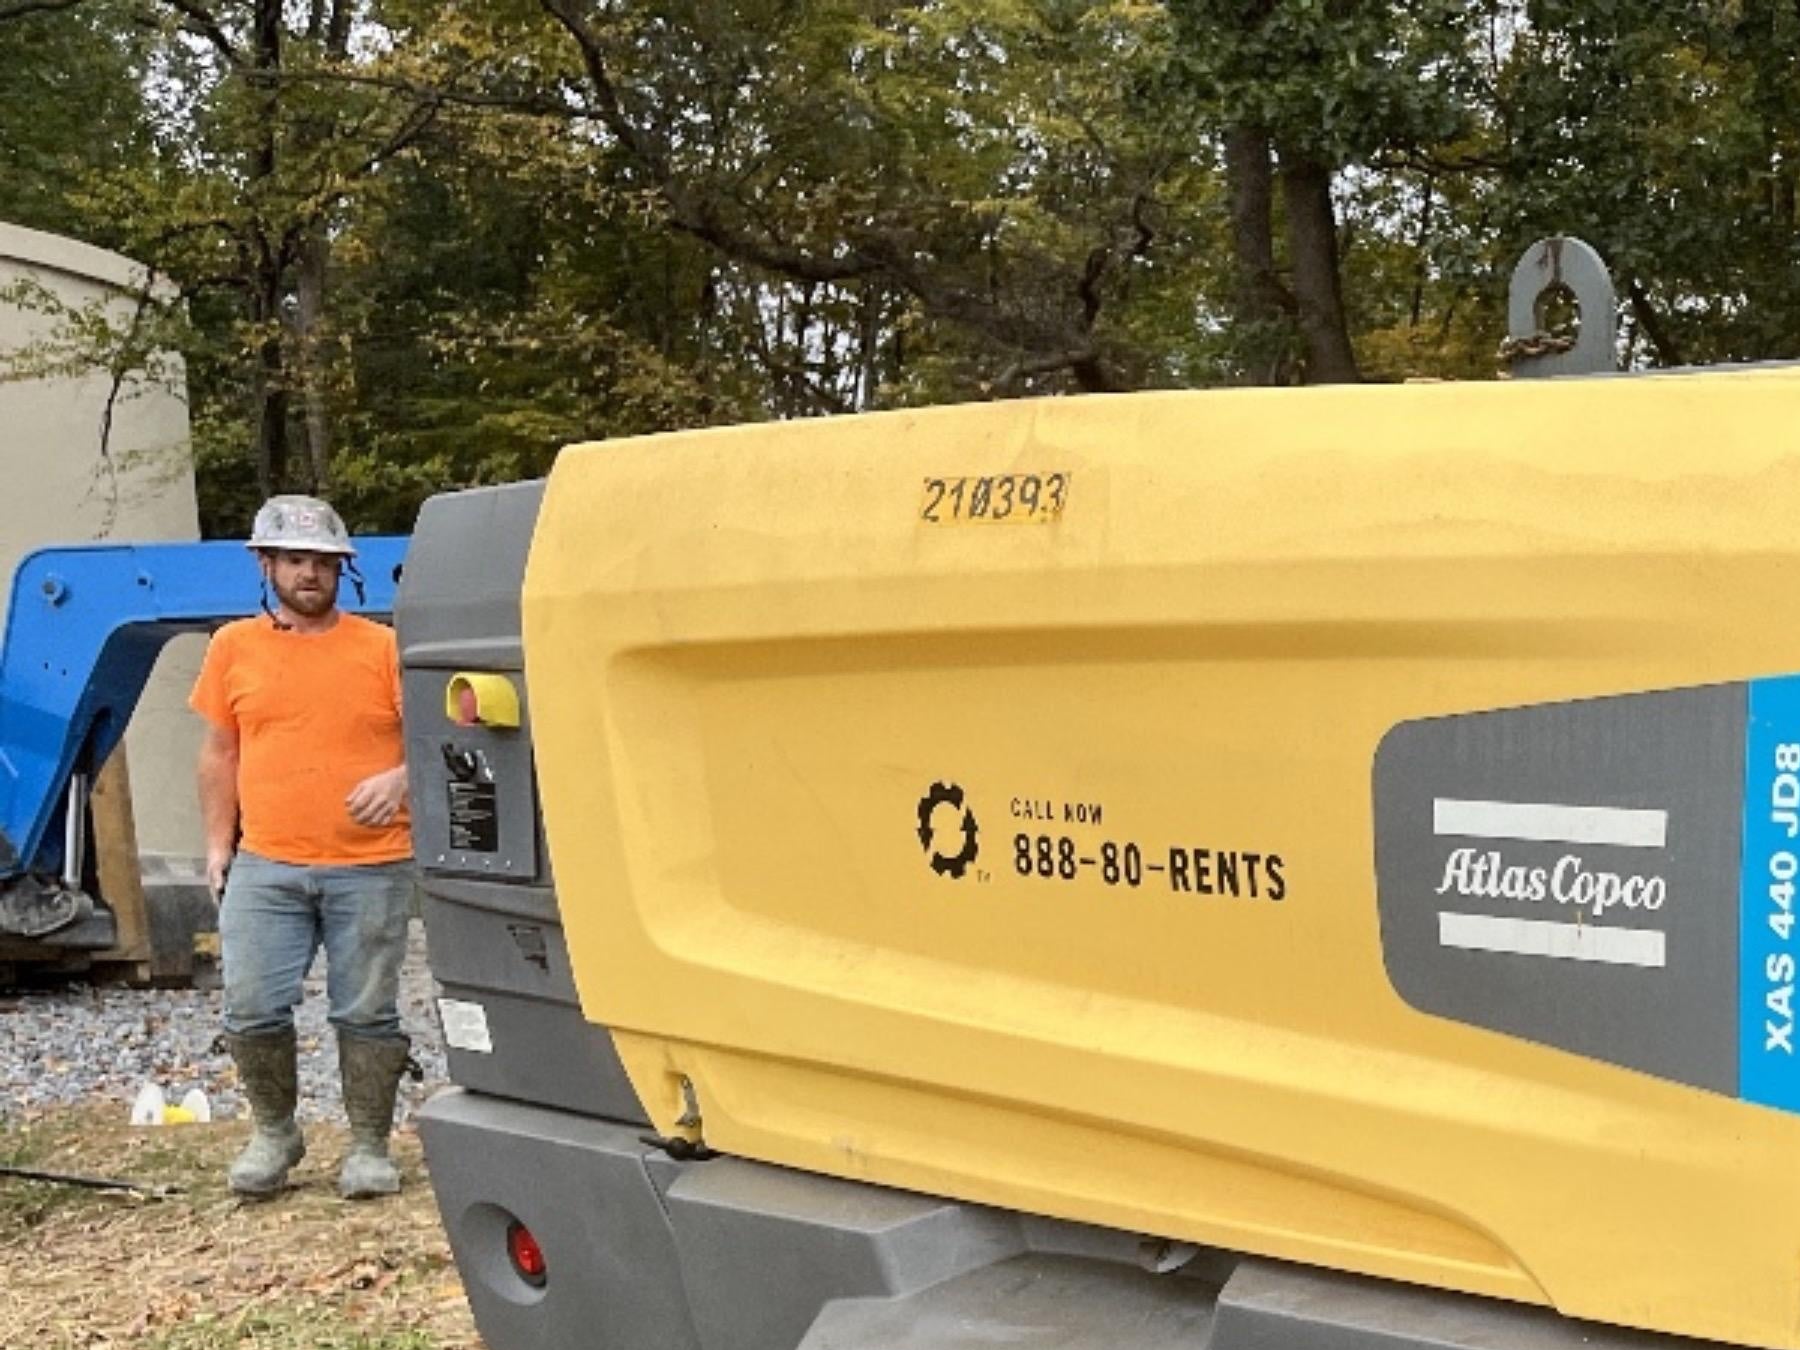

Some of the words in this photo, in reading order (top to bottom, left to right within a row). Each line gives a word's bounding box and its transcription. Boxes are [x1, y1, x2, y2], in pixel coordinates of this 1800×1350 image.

[921, 473, 1066, 523] 210393
[1010, 797, 1054, 820] CALL
[1063, 802, 1103, 825] NOW
[1013, 832, 1286, 901] 888-80-RENTS
[1769, 851, 1799, 941] 440
[1766, 953, 1797, 1056] XAS
